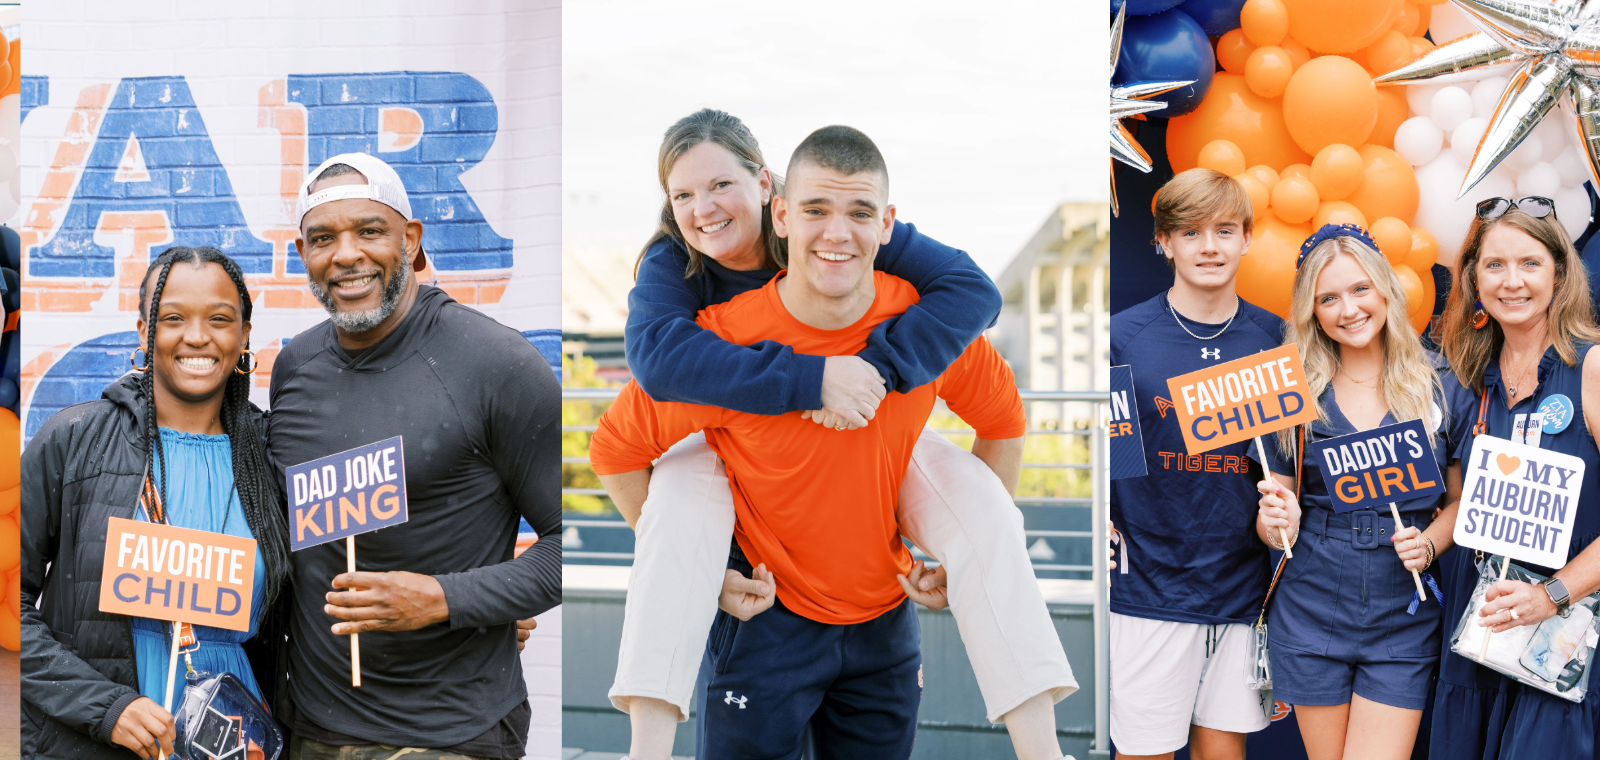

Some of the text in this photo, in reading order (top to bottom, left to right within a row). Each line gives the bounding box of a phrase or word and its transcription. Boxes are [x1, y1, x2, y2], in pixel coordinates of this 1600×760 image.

[1181, 356, 1298, 416] FAVORITE
[1191, 391, 1304, 442] CHILD
[293, 446, 398, 507] DAD JOKE
[1158, 451, 1250, 474] TIGERS
[1334, 462, 1437, 504] GIRL
[1478, 449, 1576, 490] I MY
[295, 483, 401, 542] KING
[1469, 475, 1569, 525] AUBURN
[1464, 508, 1562, 554] STUDENT
[117, 532, 246, 585] FAVORITE
[112, 572, 242, 616] CHILD
